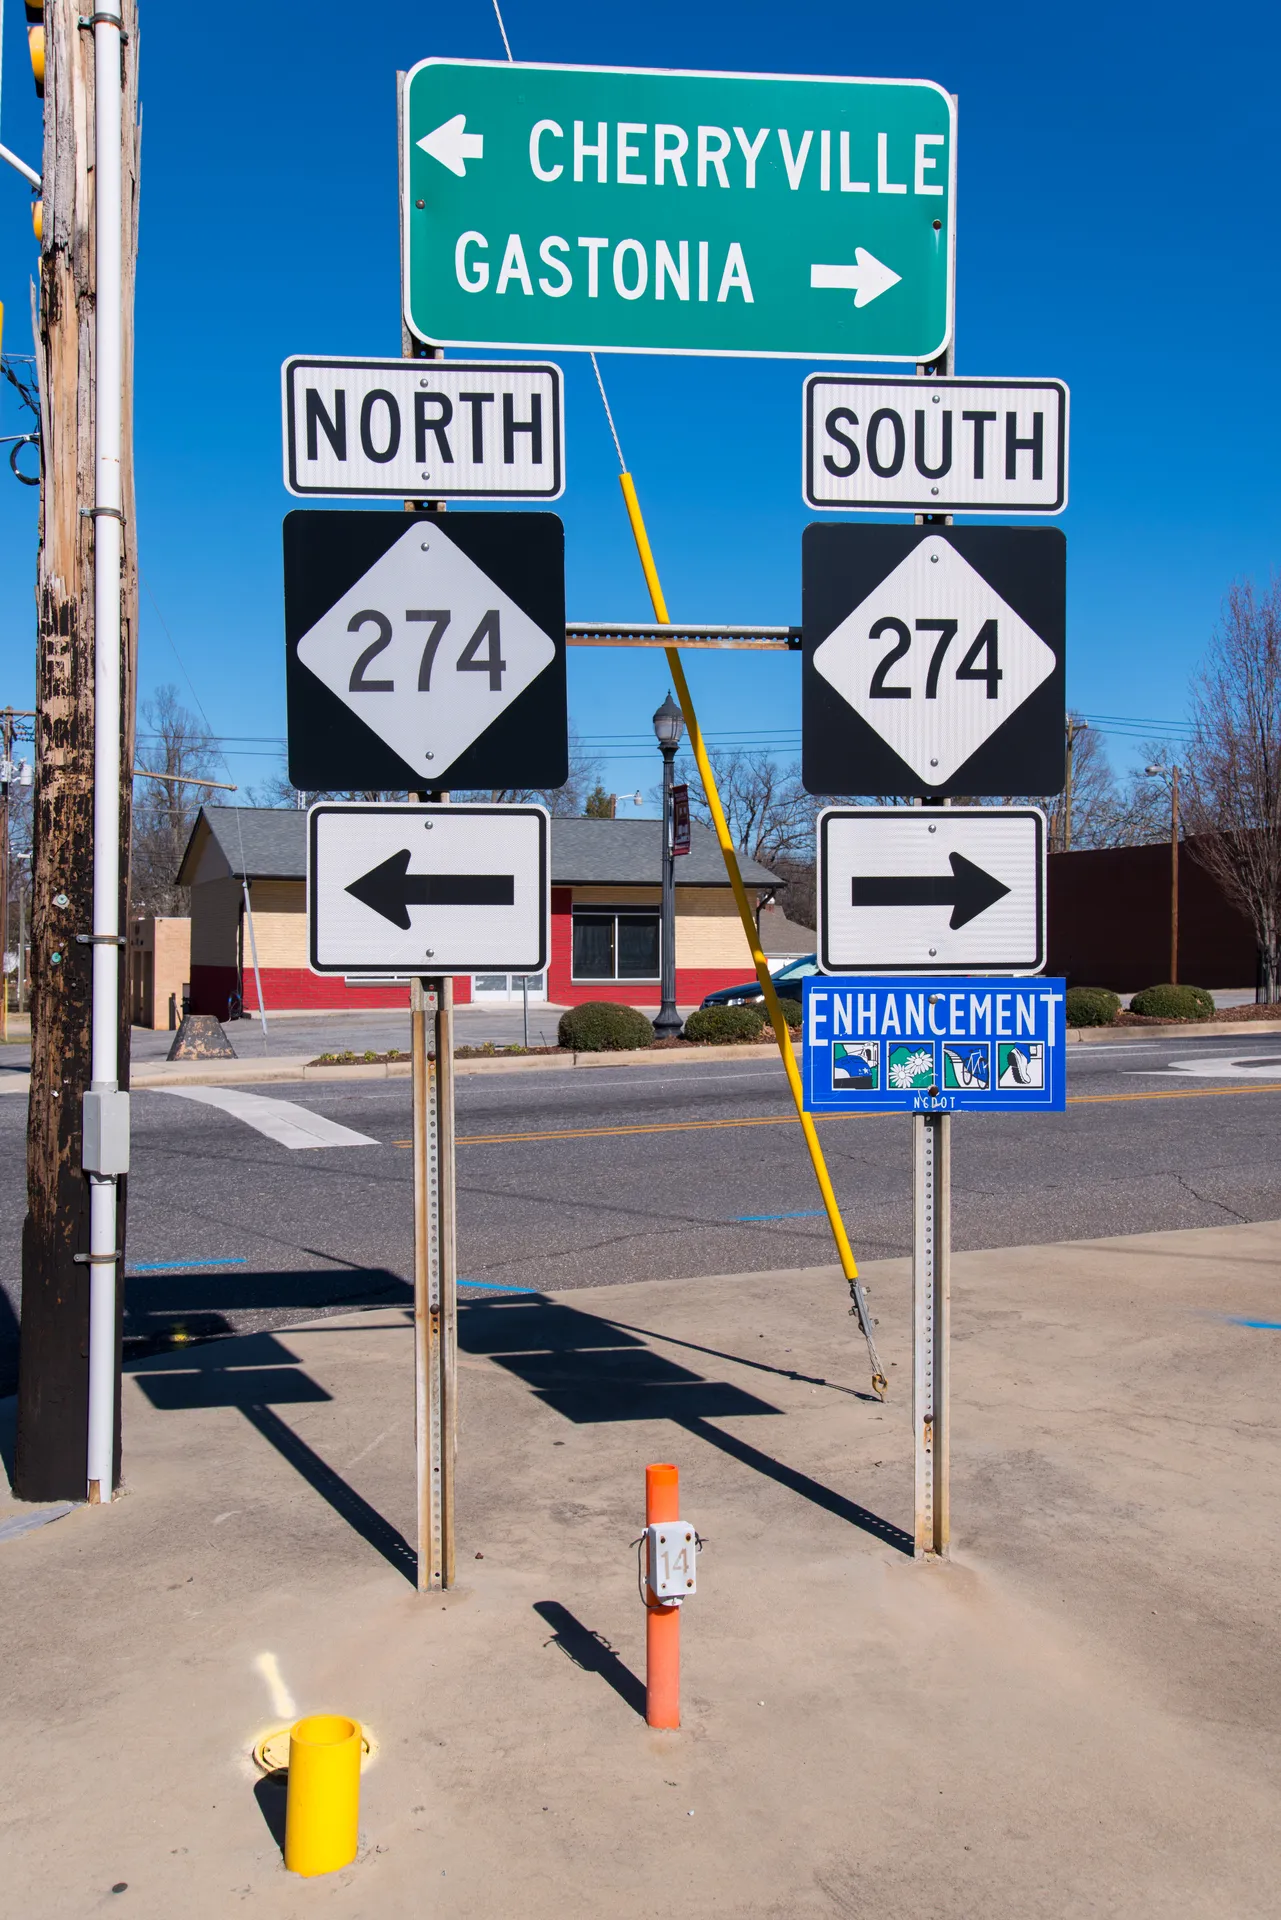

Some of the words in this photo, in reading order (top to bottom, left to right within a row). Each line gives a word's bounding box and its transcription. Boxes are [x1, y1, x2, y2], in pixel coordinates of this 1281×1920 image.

[529, 119, 945, 195] CHERRYVILLE
[455, 231, 754, 303] GASTONIA
[305, 388, 542, 465] NORTH
[823, 407, 1044, 481] SOUTH
[346, 609, 506, 693] 274
[868, 616, 1003, 700] 274
[808, 993, 1063, 1047] ENHANCEMENT
[660, 1547, 689, 1580] 14
